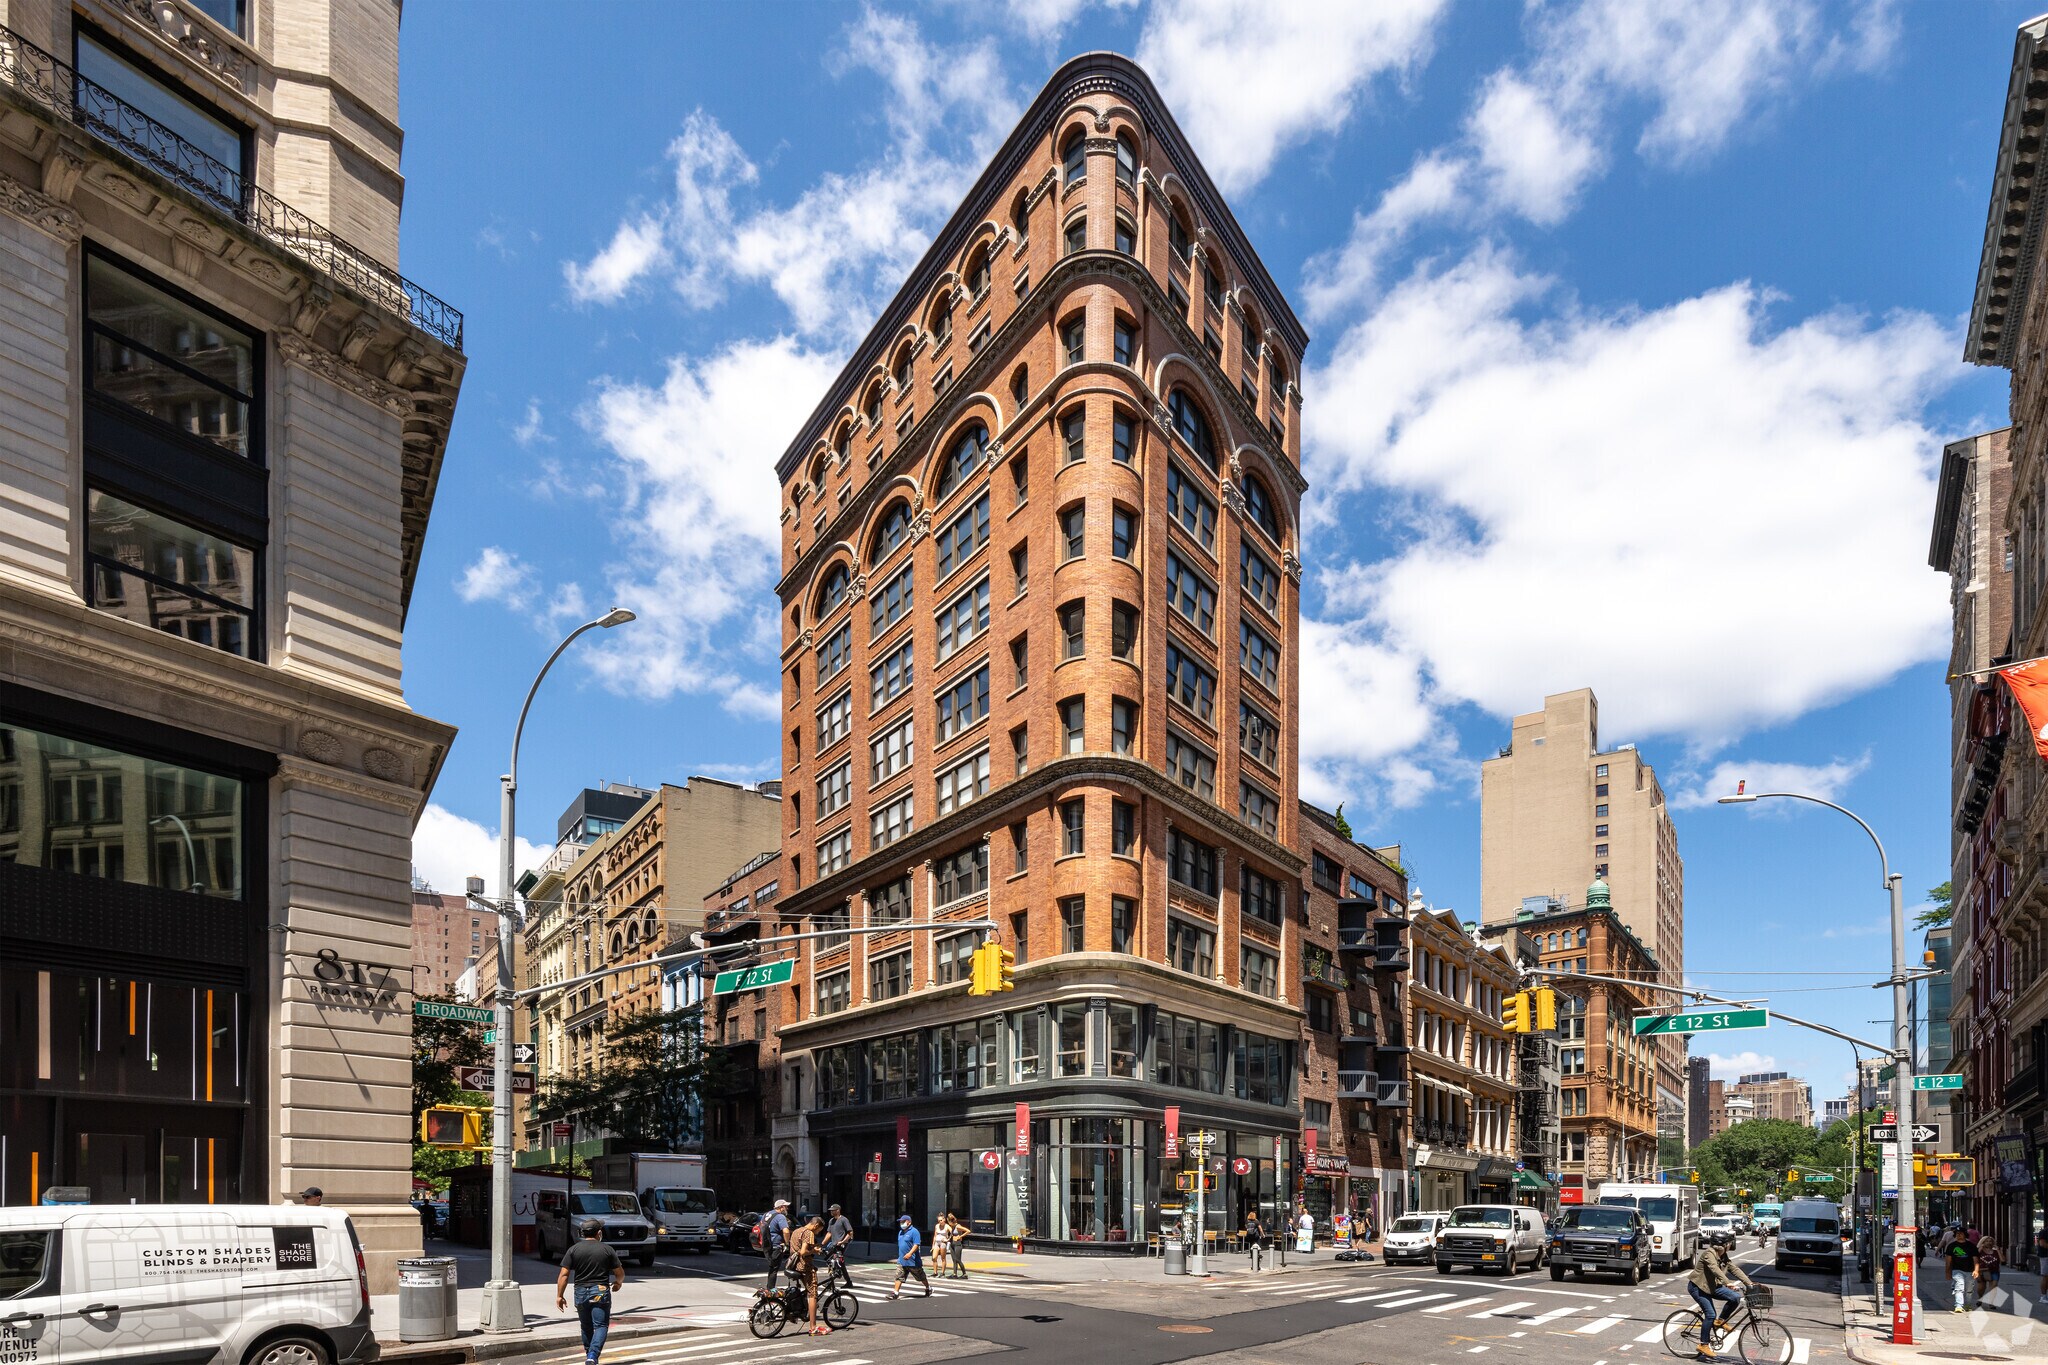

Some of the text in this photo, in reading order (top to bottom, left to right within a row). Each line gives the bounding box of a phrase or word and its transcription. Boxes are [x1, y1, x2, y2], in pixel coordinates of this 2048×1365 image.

[313, 948, 392, 1008] 817
[735, 968, 772, 987] E 12 St
[309, 985, 397, 1002] BROADWAY
[421, 1003, 490, 1021] BROADWAY
[1669, 1014, 1730, 1030] E 12 St
[486, 1031, 496, 1042] E 12
[515, 1049, 528, 1057] WAY
[473, 1075, 526, 1087] ONE AY
[1918, 1078, 1926, 1089] E
[1931, 1077, 1944, 1088] 12
[1879, 1130, 1898, 1138] ONE
[1017, 1135, 1029, 1152] PRET
[1167, 1139, 1177, 1156] PRET
[1998, 1147, 2026, 1163] PLANET
[1017, 1185, 1029, 1212] PRET
[143, 1247, 271, 1257] CUSTOM SHADES
[144, 1256, 272, 1267] BLINDS & DRAPERY
